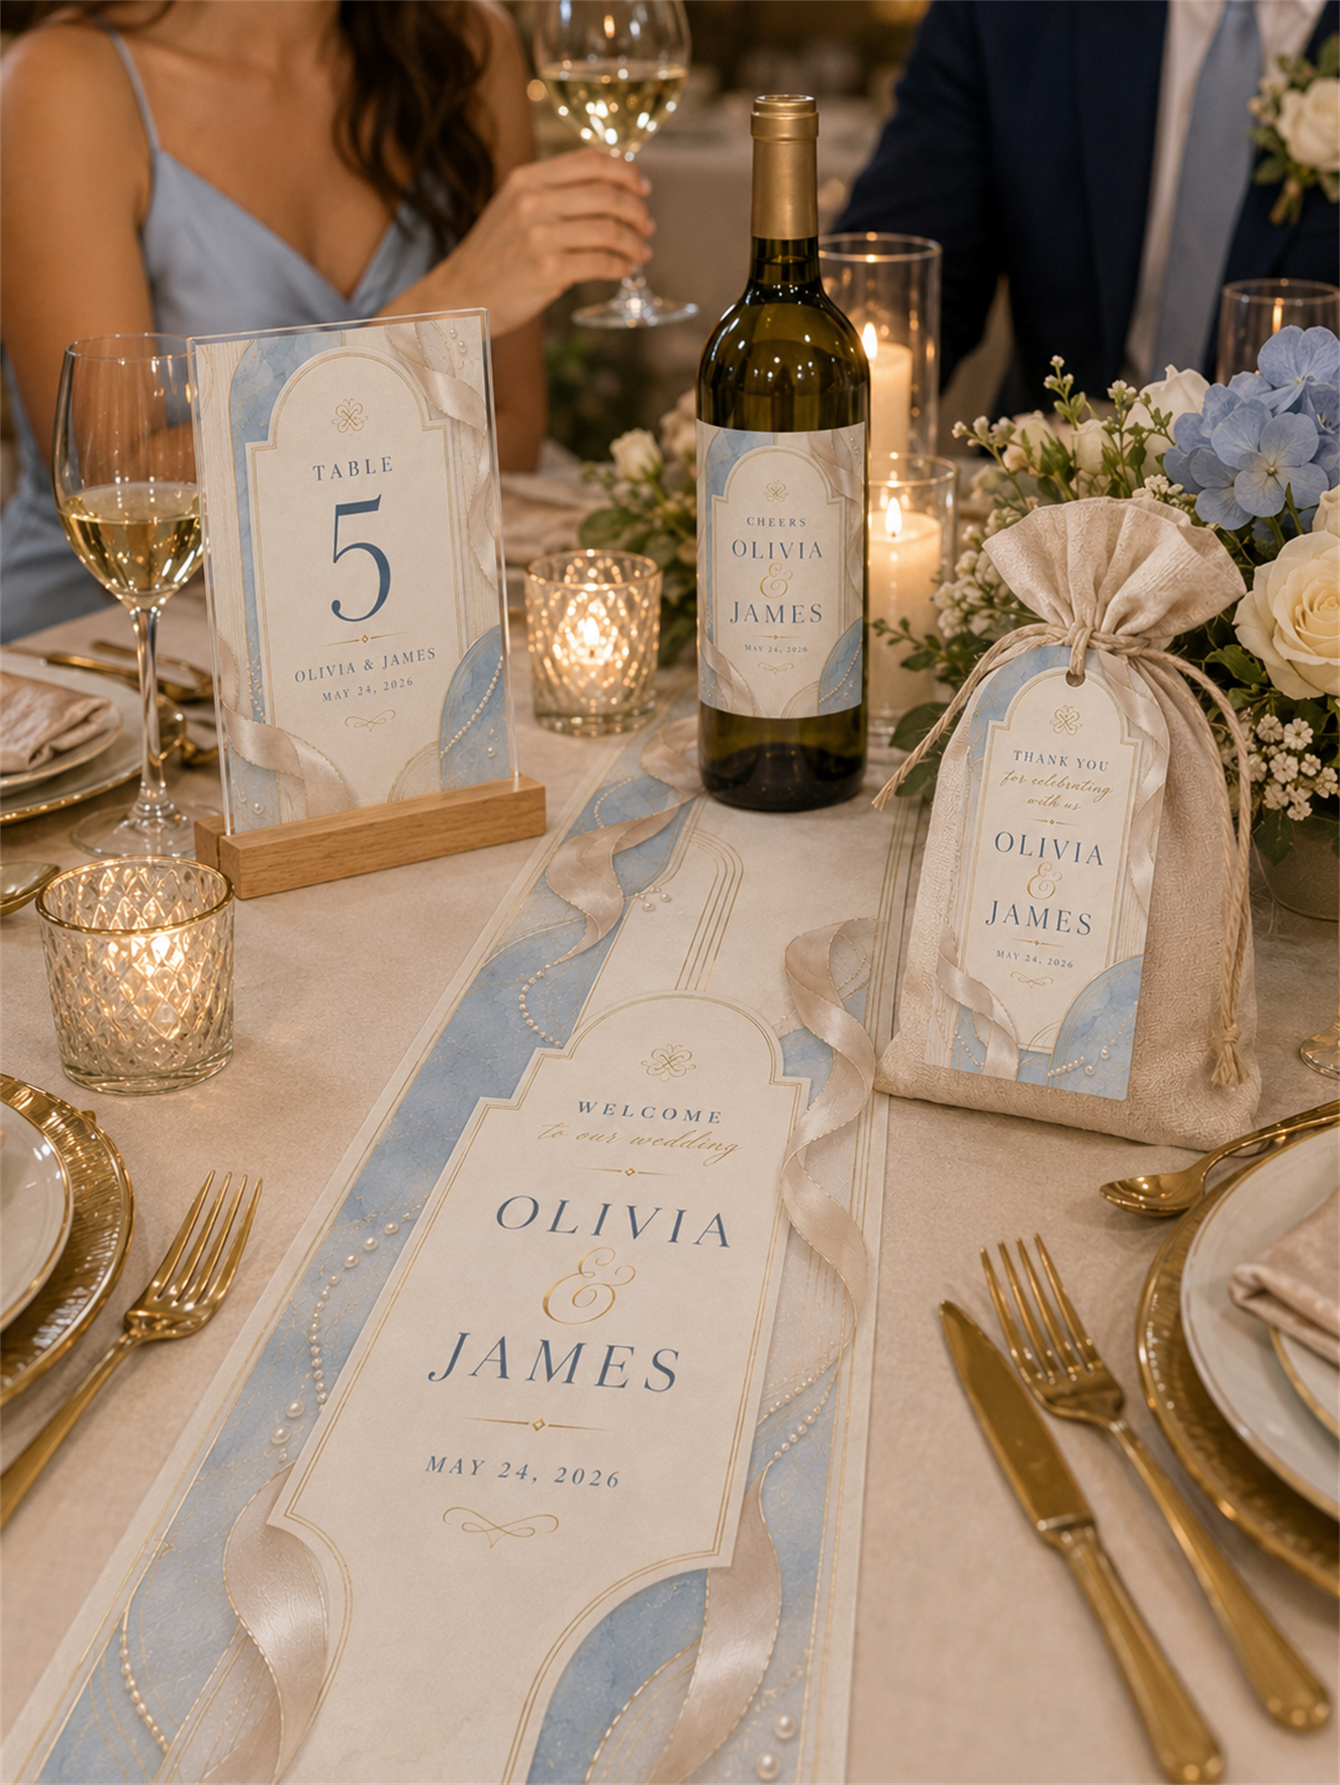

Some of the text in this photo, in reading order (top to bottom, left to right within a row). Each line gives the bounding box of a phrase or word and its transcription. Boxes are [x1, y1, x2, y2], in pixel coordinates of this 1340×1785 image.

[313, 457, 393, 481] TABLE
[747, 517, 806, 527] CHEERS
[331, 494, 391, 622] 5
[732, 540, 822, 559] OLIVIA
[760, 563, 793, 598] &
[730, 601, 822, 624] JAMES
[745, 644, 762, 652] MAY
[295, 647, 436, 683] OLIVIA & JAMES
[323, 677, 413, 702] MAY 24, 2026
[1013, 751, 1108, 771] THANK YOU
[1000, 770, 1113, 803] for celebrating
[1027, 795, 1081, 811] with us
[995, 832, 1103, 865] OLIVIA
[1027, 862, 1063, 900] &
[985, 900, 1092, 935] JAMES
[996, 950, 1073, 968] MAY 24, 2026
[578, 1101, 723, 1124] WELCOME
[537, 1122, 744, 1166] to our wedding
[495, 1195, 730, 1248] OLIVIA
[542, 1247, 636, 1325] &
[428, 1332, 680, 1393] JAMES
[425, 1455, 620, 1489] MAY 24, 2026
